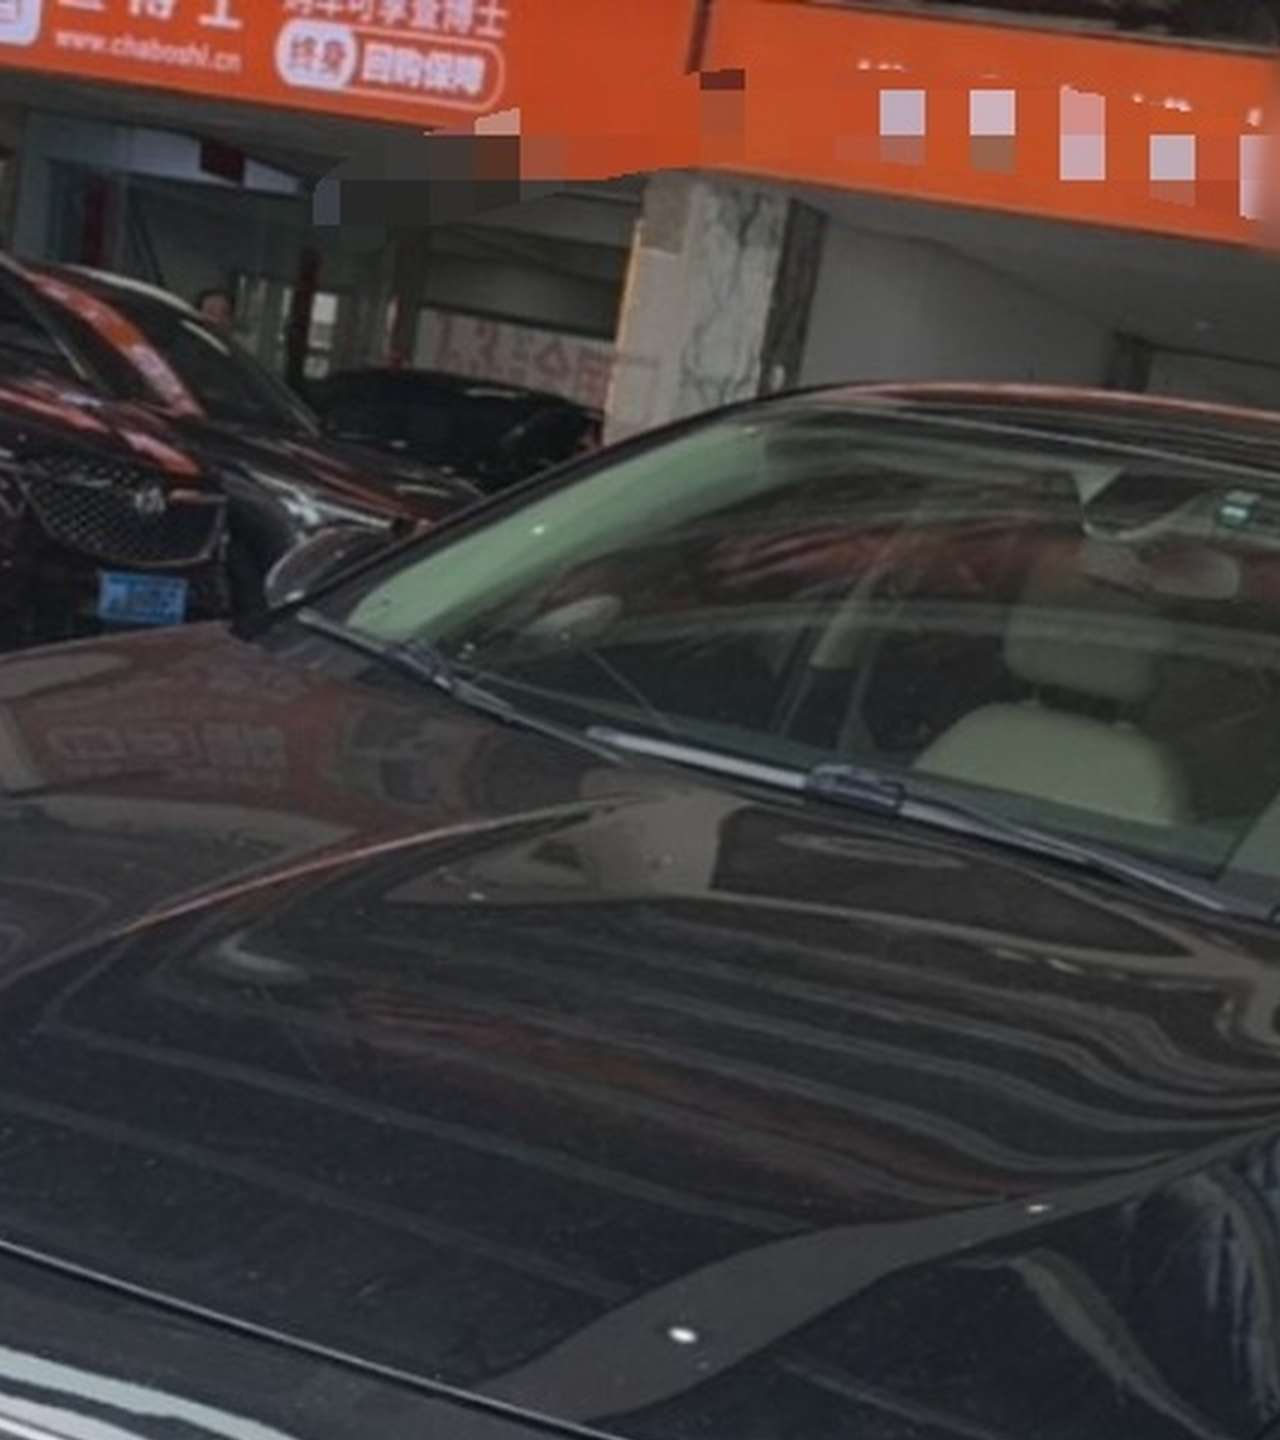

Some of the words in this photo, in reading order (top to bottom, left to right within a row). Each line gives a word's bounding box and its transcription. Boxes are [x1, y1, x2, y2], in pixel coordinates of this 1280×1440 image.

[55, 30, 242, 72] www.chaboshi.cn
[363, 42, 486, 94] 回购保障
